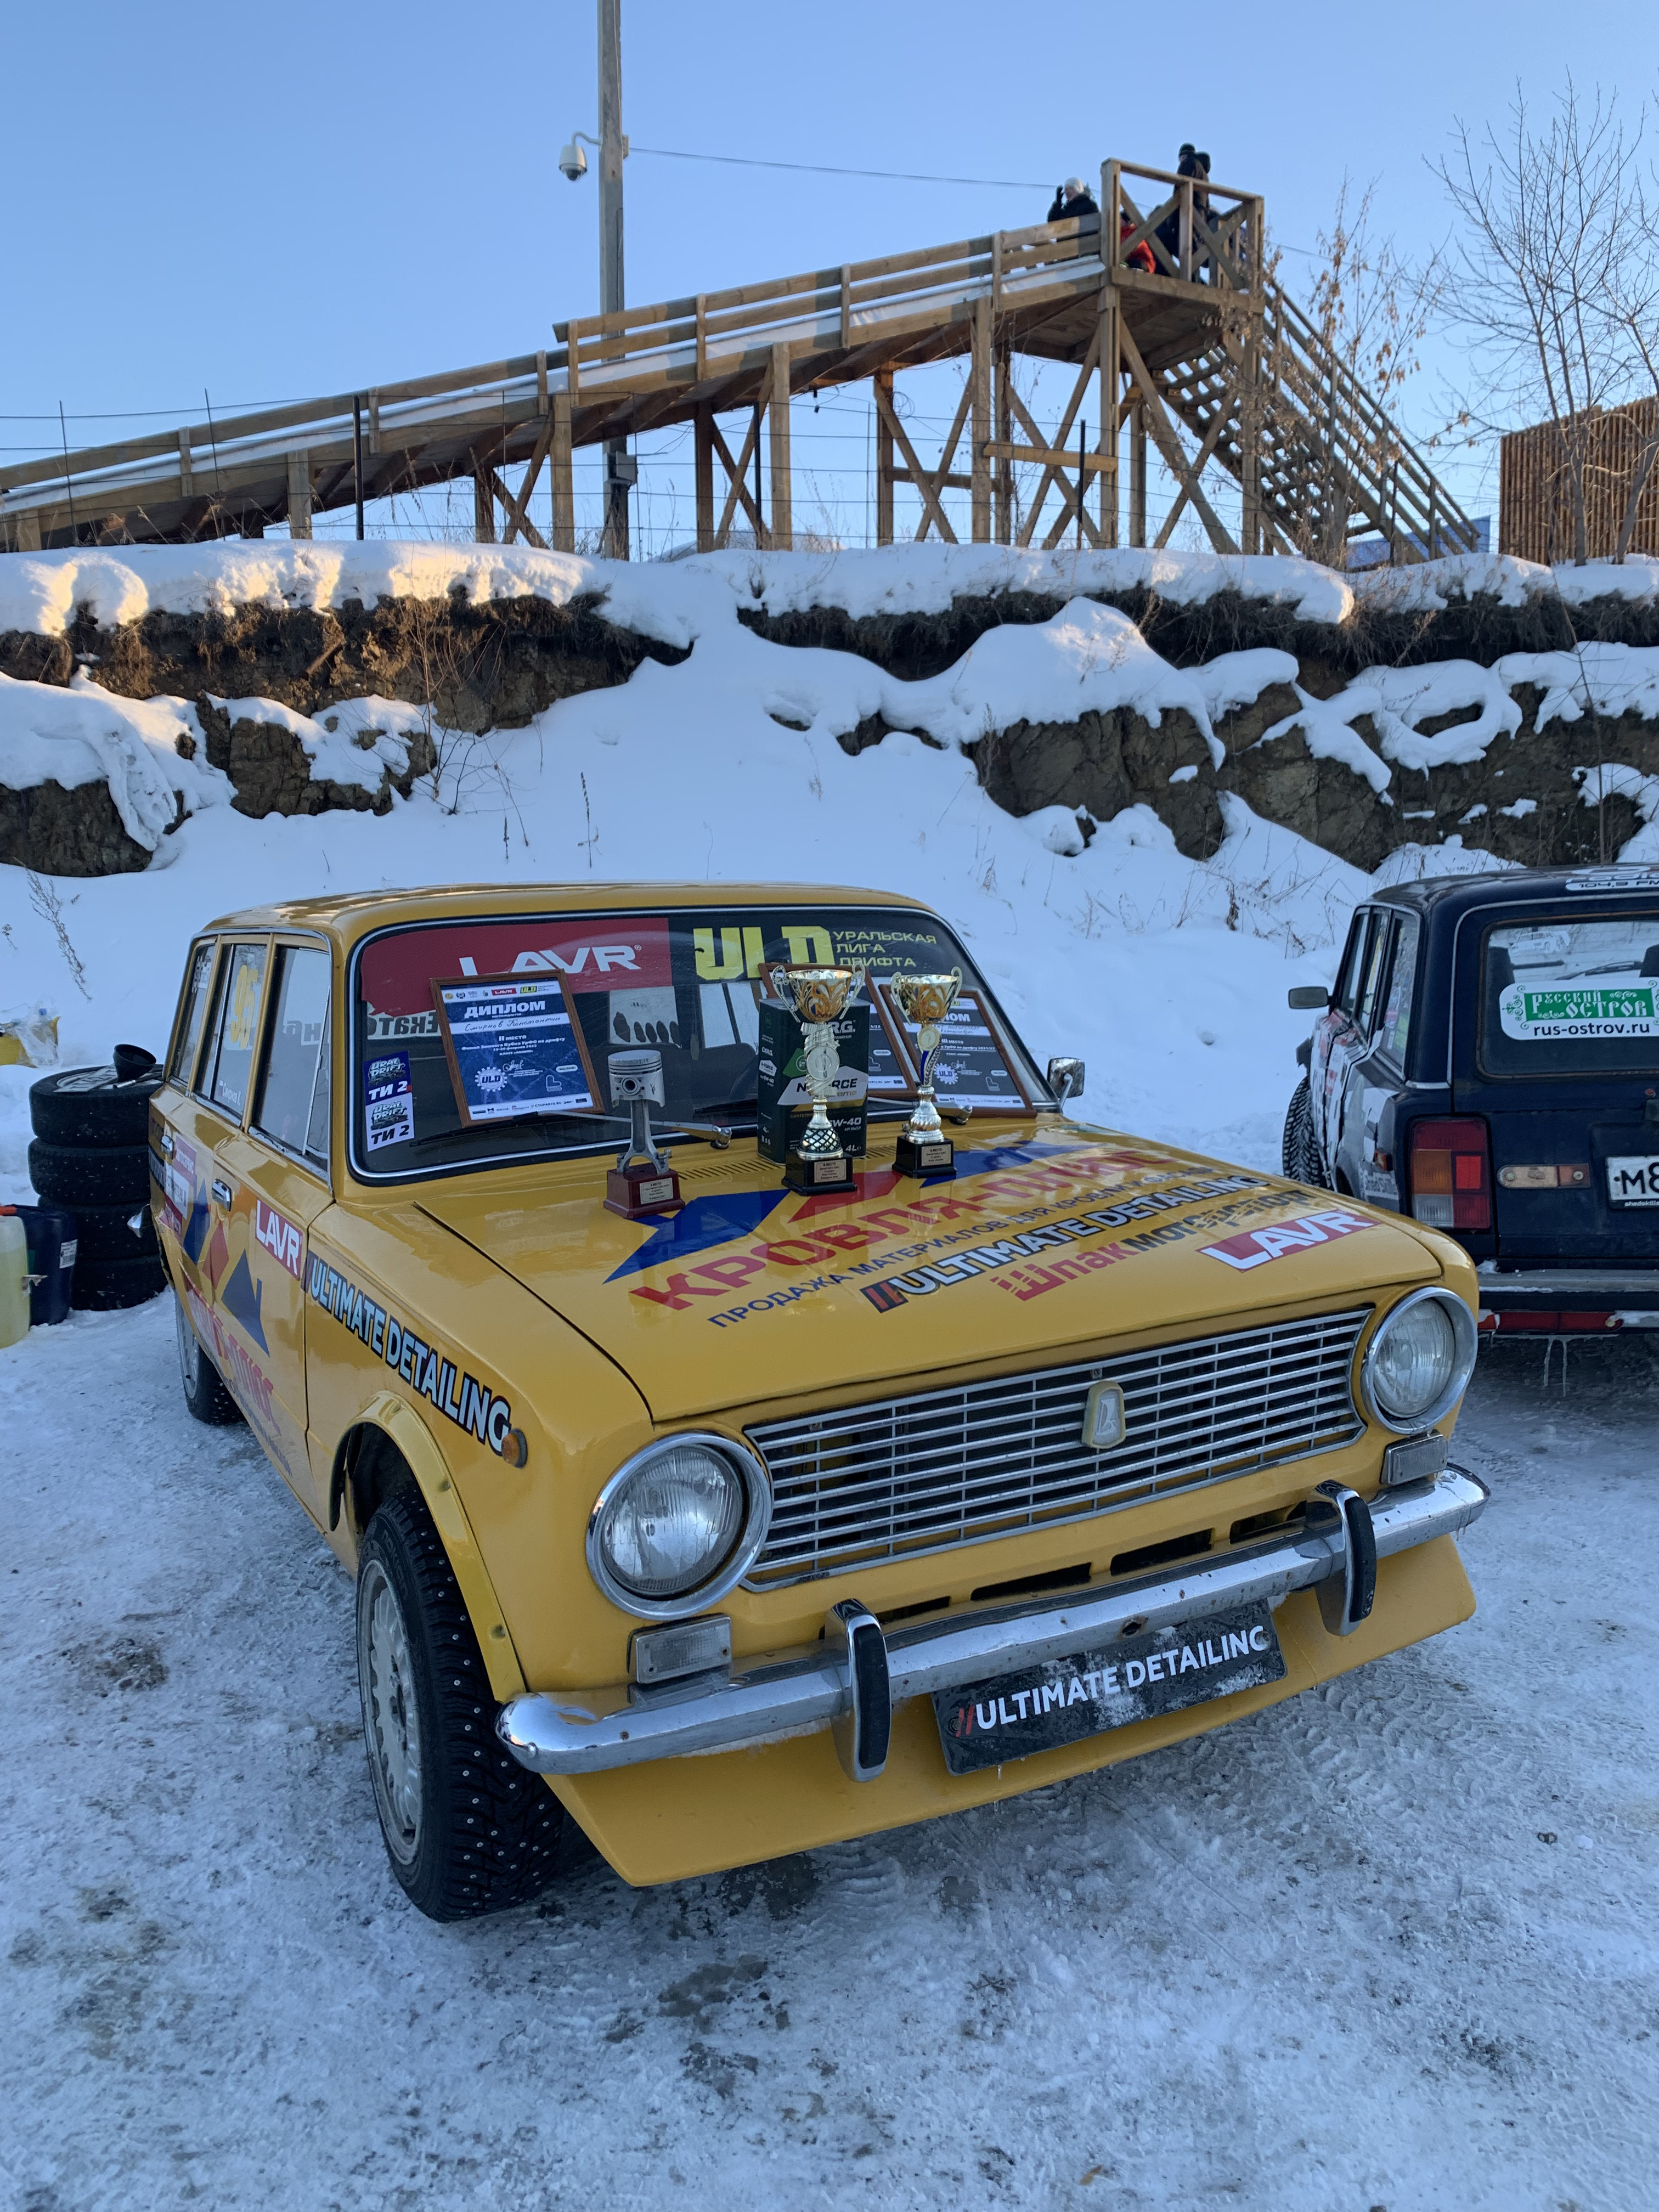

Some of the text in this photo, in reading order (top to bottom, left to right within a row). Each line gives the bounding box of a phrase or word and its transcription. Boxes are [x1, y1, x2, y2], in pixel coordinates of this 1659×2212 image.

[833, 931, 936, 944] УРАЛЬСКАЯ
[836, 943, 886, 953] ЛИГА
[464, 1000, 545, 1019] ДИПЛОМ
[465, 1020, 503, 1032] Смирнов
[1534, 1022, 1650, 1036] rus-ostrov.ru
[397, 1080, 408, 1092] 2
[482, 1075, 501, 1084] ULD
[399, 1125, 410, 1136] 2
[1085, 1175, 1268, 1227] DETAILING
[256, 1199, 299, 1276] LAVR
[1200, 1210, 1367, 1271] LAVR
[708, 1271, 854, 1328] ПРОДАЖА
[850, 1217, 1011, 1276] МАТЕРИАЛОВ
[1006, 1206, 1056, 1224] ДЛЯ
[310, 1257, 386, 1358] ULTIMATE
[385, 1316, 511, 1454] DETAILING
